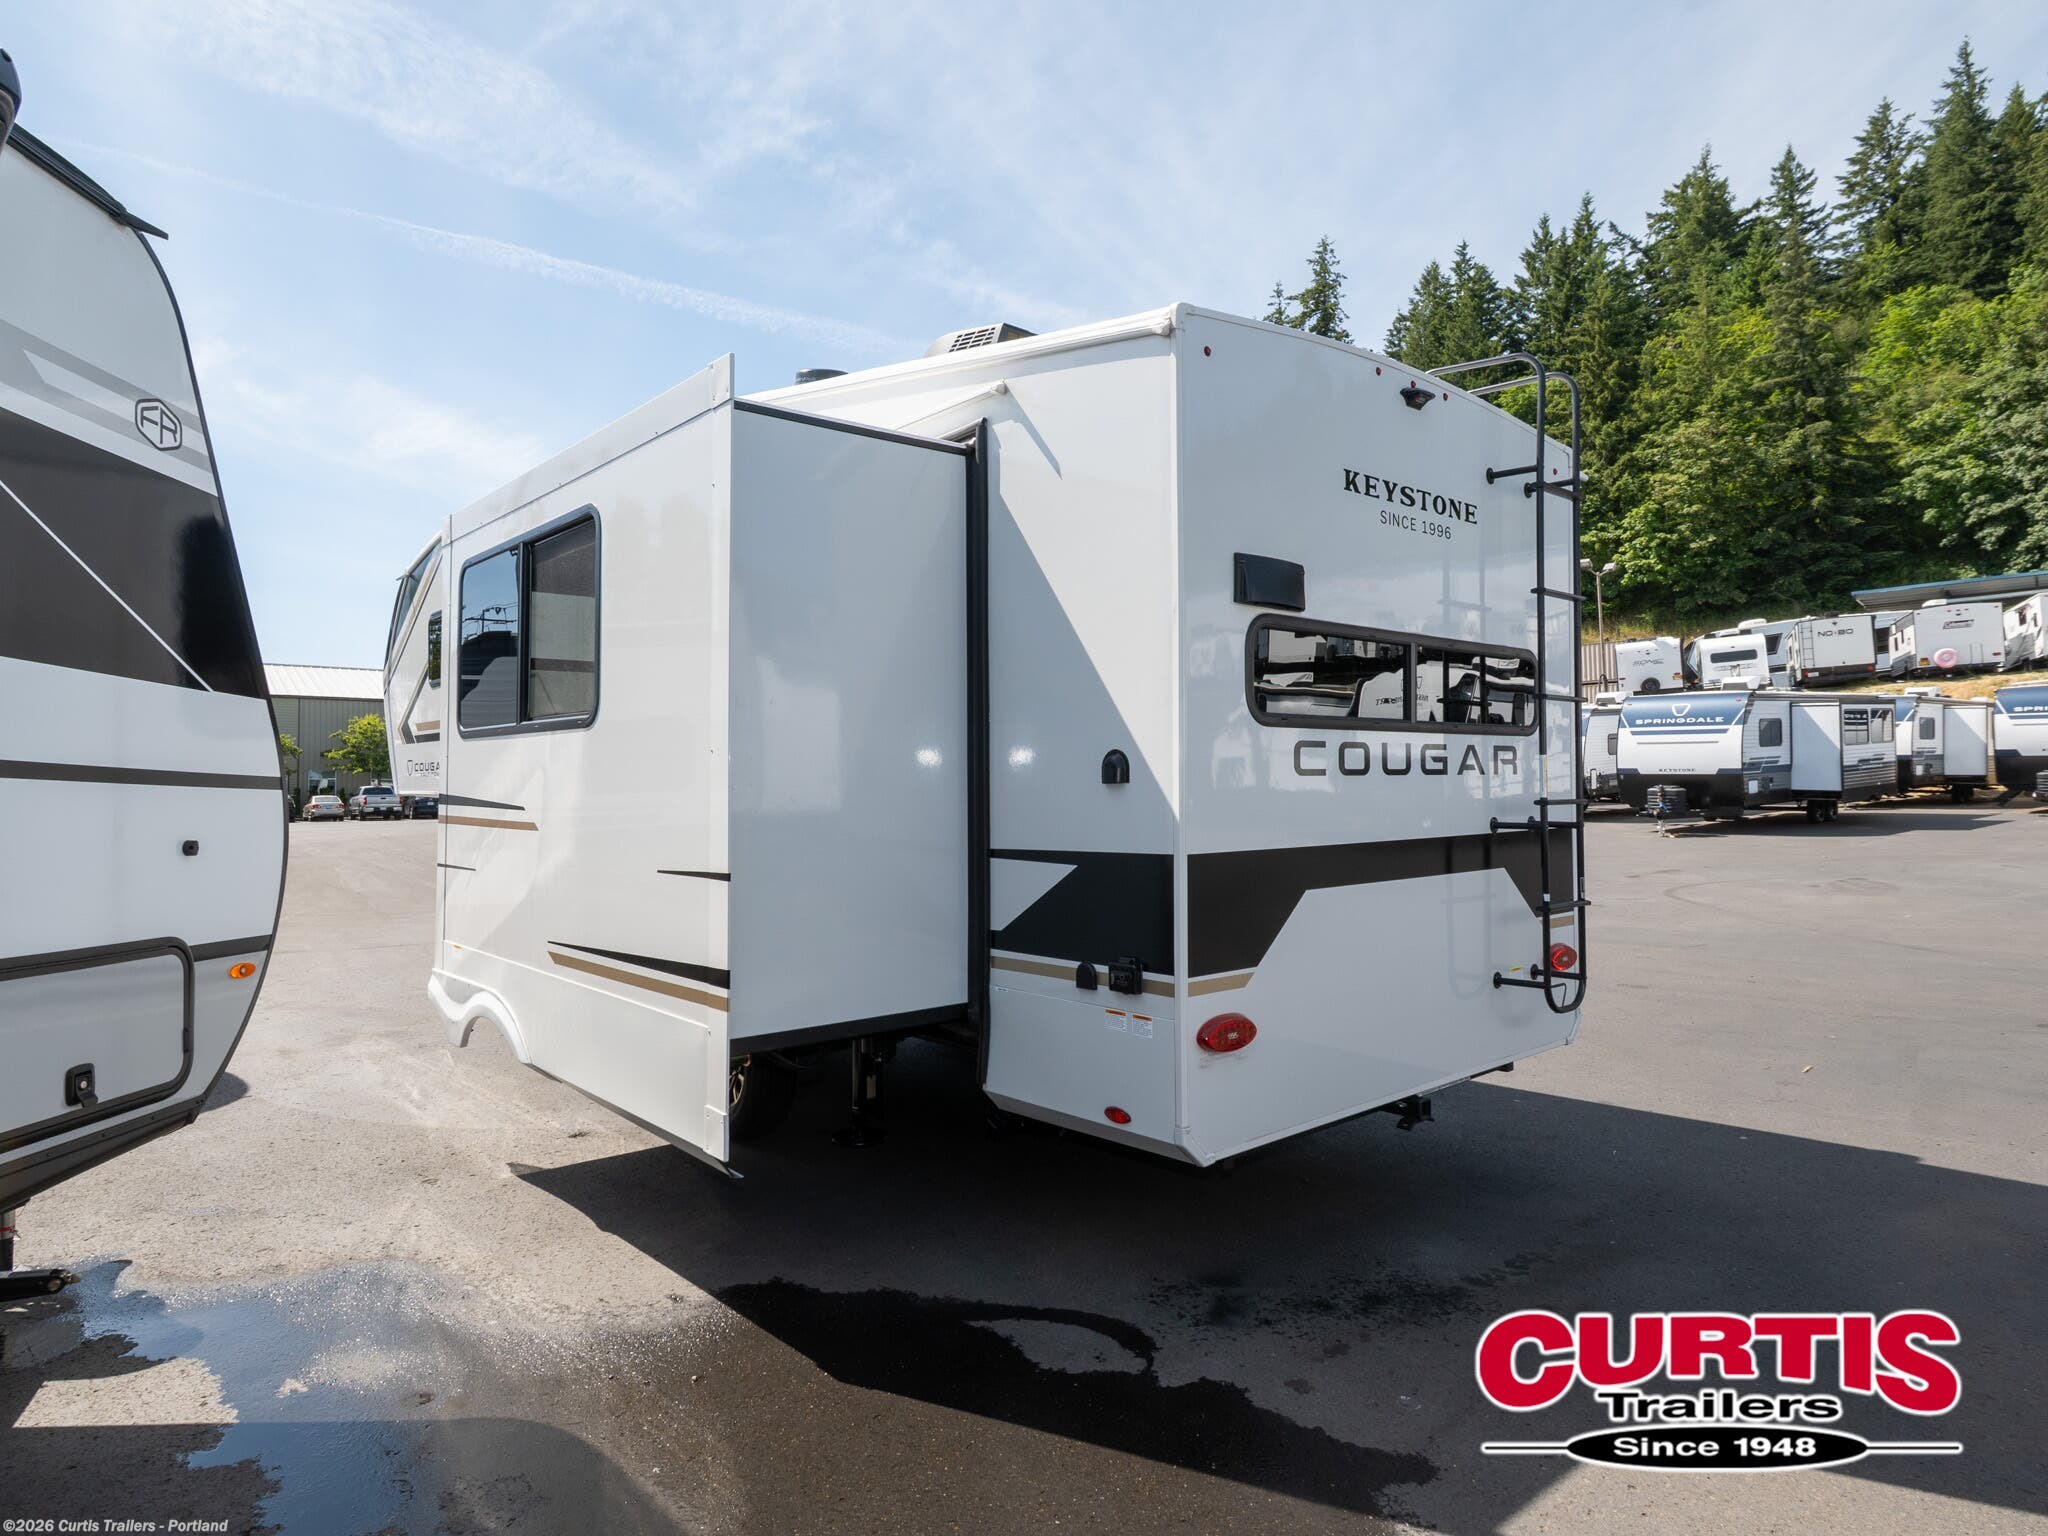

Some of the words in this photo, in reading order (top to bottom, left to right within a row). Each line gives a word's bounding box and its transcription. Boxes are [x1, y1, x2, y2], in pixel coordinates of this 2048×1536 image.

[141, 406, 178, 444] FR
[1343, 468, 1478, 525] KEYSTONE
[1379, 509, 1417, 532] SINCE
[1421, 520, 1452, 540] 1996
[1635, 716, 1724, 725] SPRINGDALE
[1293, 740, 1519, 776] COUGAR
